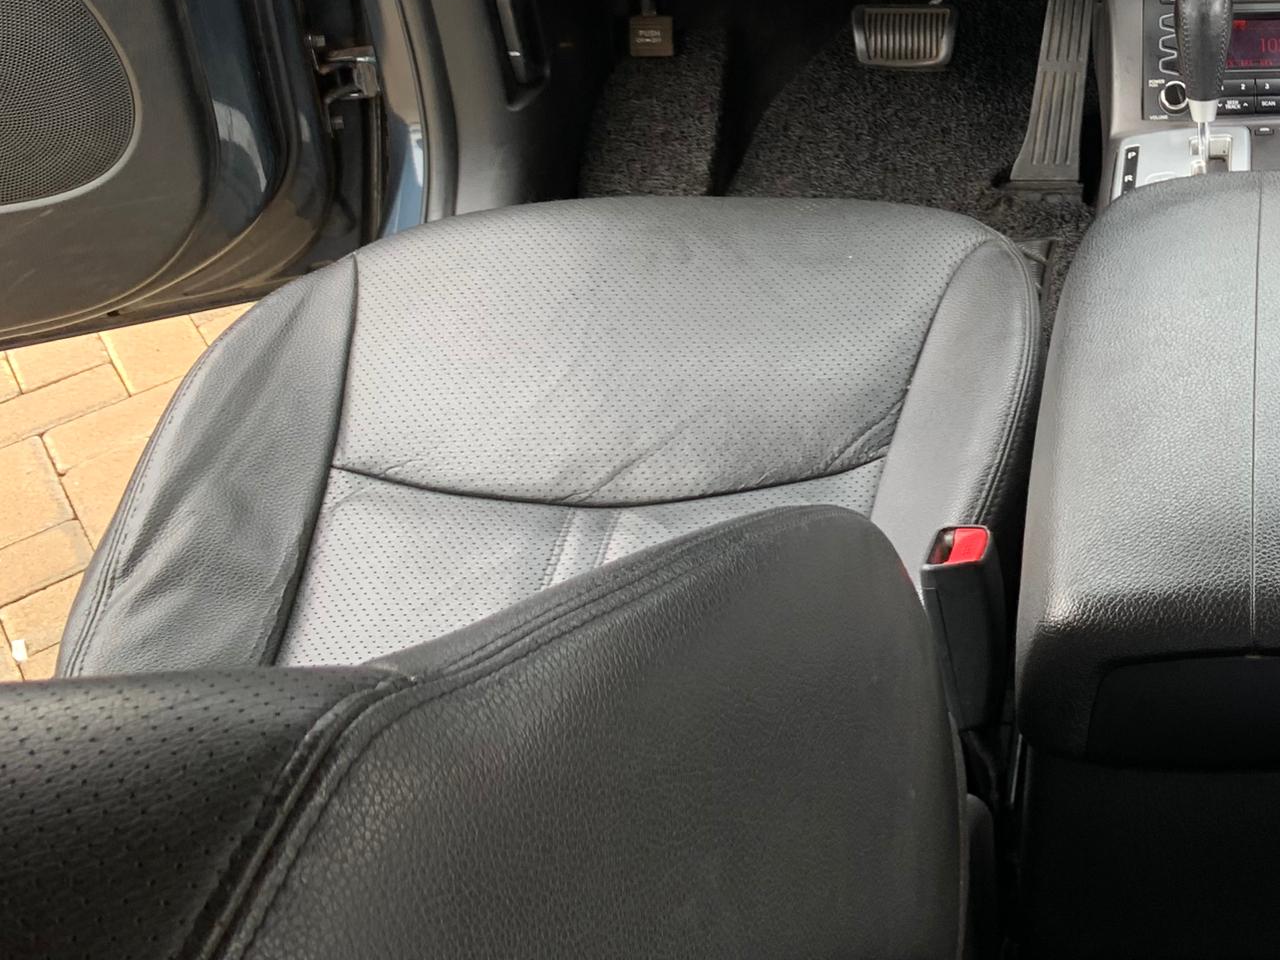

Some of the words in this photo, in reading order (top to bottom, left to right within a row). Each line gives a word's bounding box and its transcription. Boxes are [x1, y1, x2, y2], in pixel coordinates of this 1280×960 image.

[1264, 82, 1271, 90] 3
[1127, 151, 1137, 160] P
[1124, 174, 1134, 183] R
